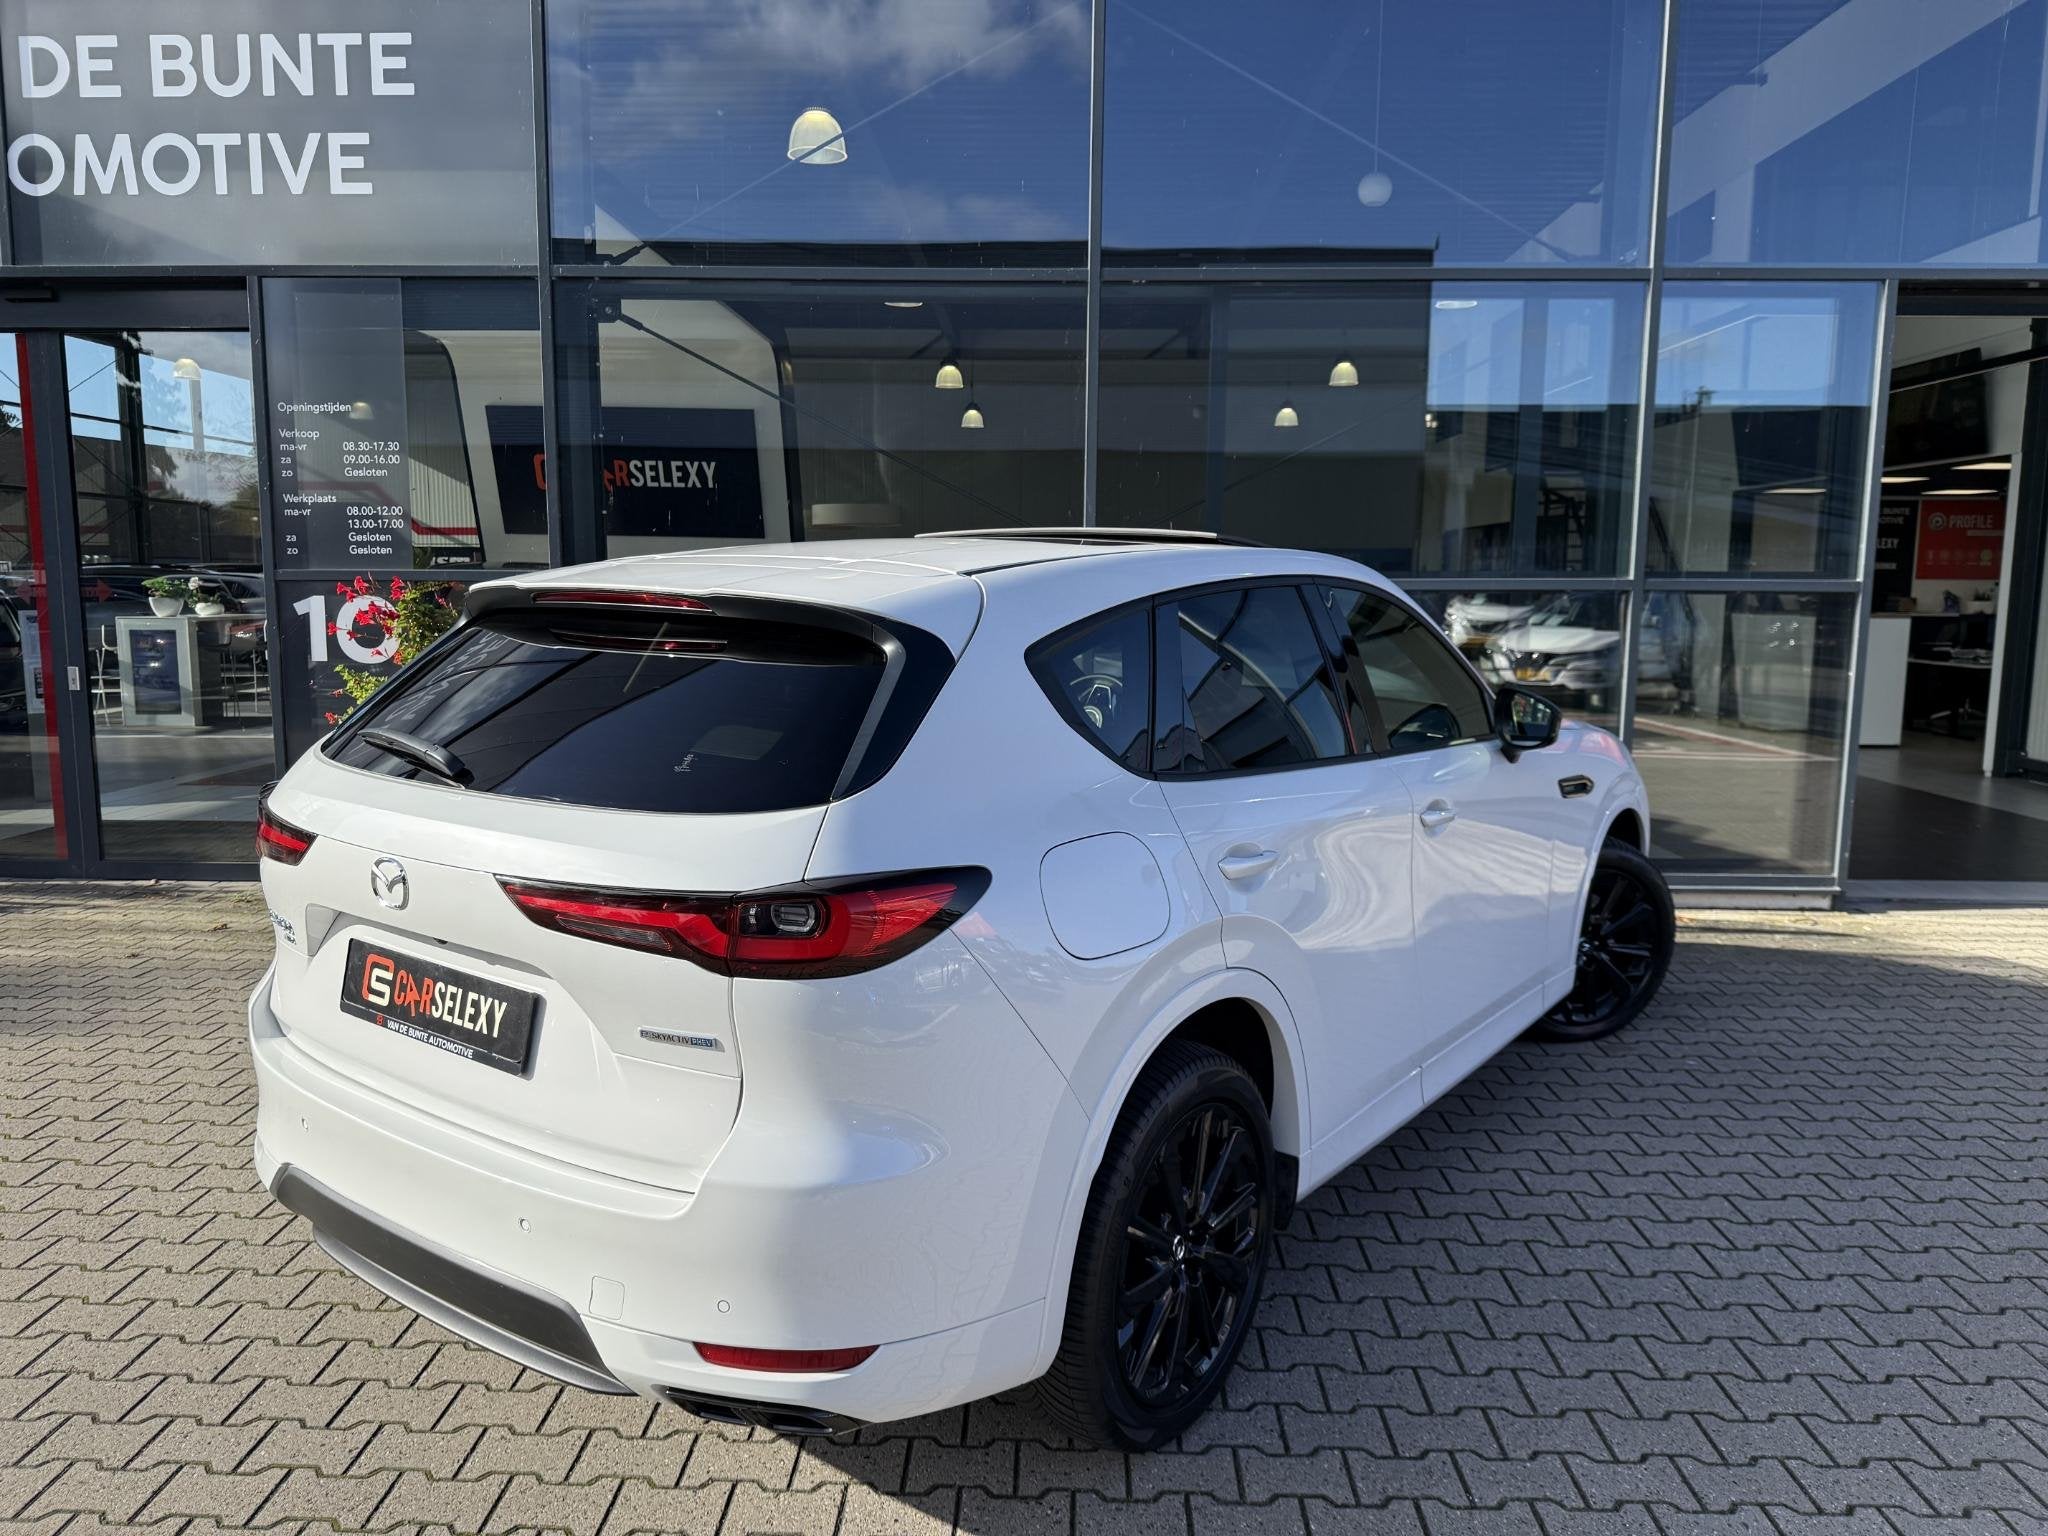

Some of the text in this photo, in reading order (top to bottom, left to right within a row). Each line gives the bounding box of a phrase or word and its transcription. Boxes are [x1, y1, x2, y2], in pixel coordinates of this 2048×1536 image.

[18, 32, 416, 98] DE BUNTE
[7, 132, 373, 197] OMOTIVE
[277, 402, 352, 414] Openingstijden
[279, 429, 320, 440] Verkoop
[280, 441, 400, 451] ma-vr 08.30-17.30
[343, 455, 400, 464] 09.00-16.00
[344, 467, 388, 477] Gesloten
[603, 460, 717, 489] RSELEXY
[283, 494, 337, 505] Werkplaats
[284, 506, 403, 516] ma-vr 08.00-12.00
[348, 519, 404, 529] 13.00-17.00
[1949, 514, 1994, 528] PROFILE
[286, 532, 392, 542] za Gesloten
[287, 545, 393, 555] zo Gesloten
[293, 595, 401, 664] 10
[394, 970, 508, 1039] CARSELEXY
[387, 1019, 474, 1059] VAN DE BUNTE AUTOMOTIVE
